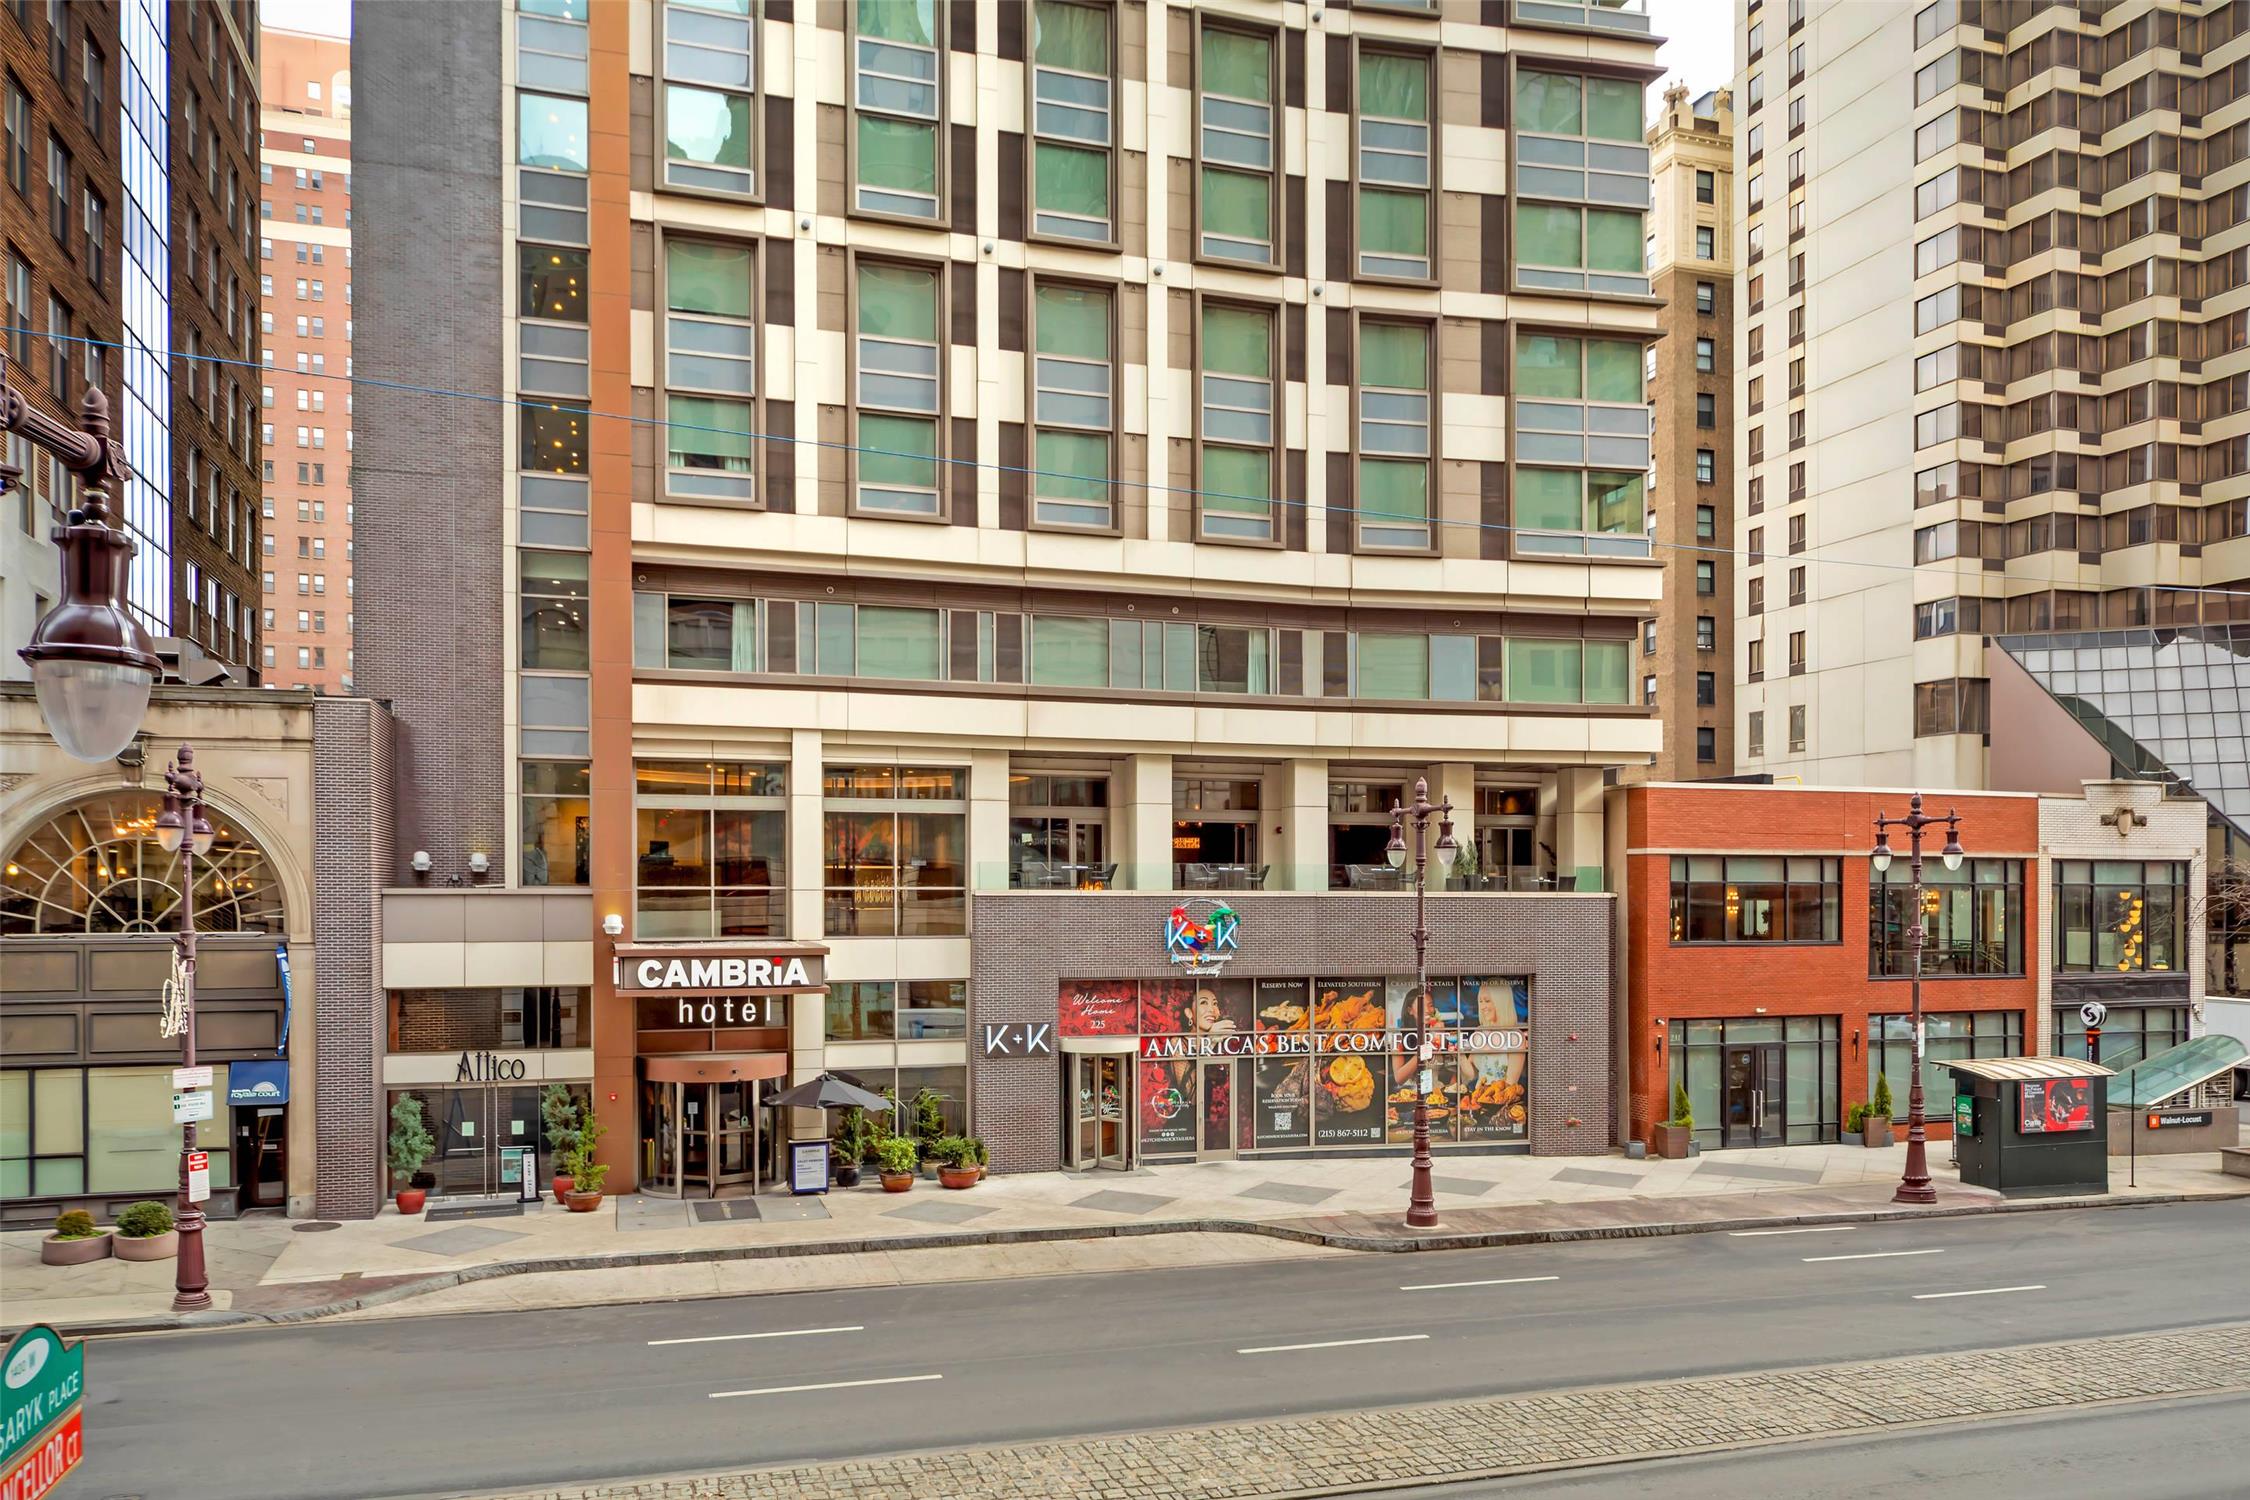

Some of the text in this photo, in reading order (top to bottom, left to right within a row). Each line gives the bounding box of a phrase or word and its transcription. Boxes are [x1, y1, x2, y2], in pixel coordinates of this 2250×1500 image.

[1261, 981, 1287, 989] RESERVE
[1072, 993, 1123, 1006] Welcome
[678, 996, 771, 1024] hotel
[1081, 1005, 1115, 1016] Home
[1090, 1020, 1106, 1029] 225
[1144, 1035, 1269, 1058] AMERICA'S
[1277, 1033, 1331, 1054] BEST
[1459, 1031, 1523, 1051] FOOD
[2160, 1116, 2202, 1125] Walnut-Locust
[1318, 1129, 1336, 1138] (215)
[1337, 1129, 1369, 1137] 867-5112
[48, 1370, 79, 1413] PLACE
[66, 1431, 79, 1465] CT
